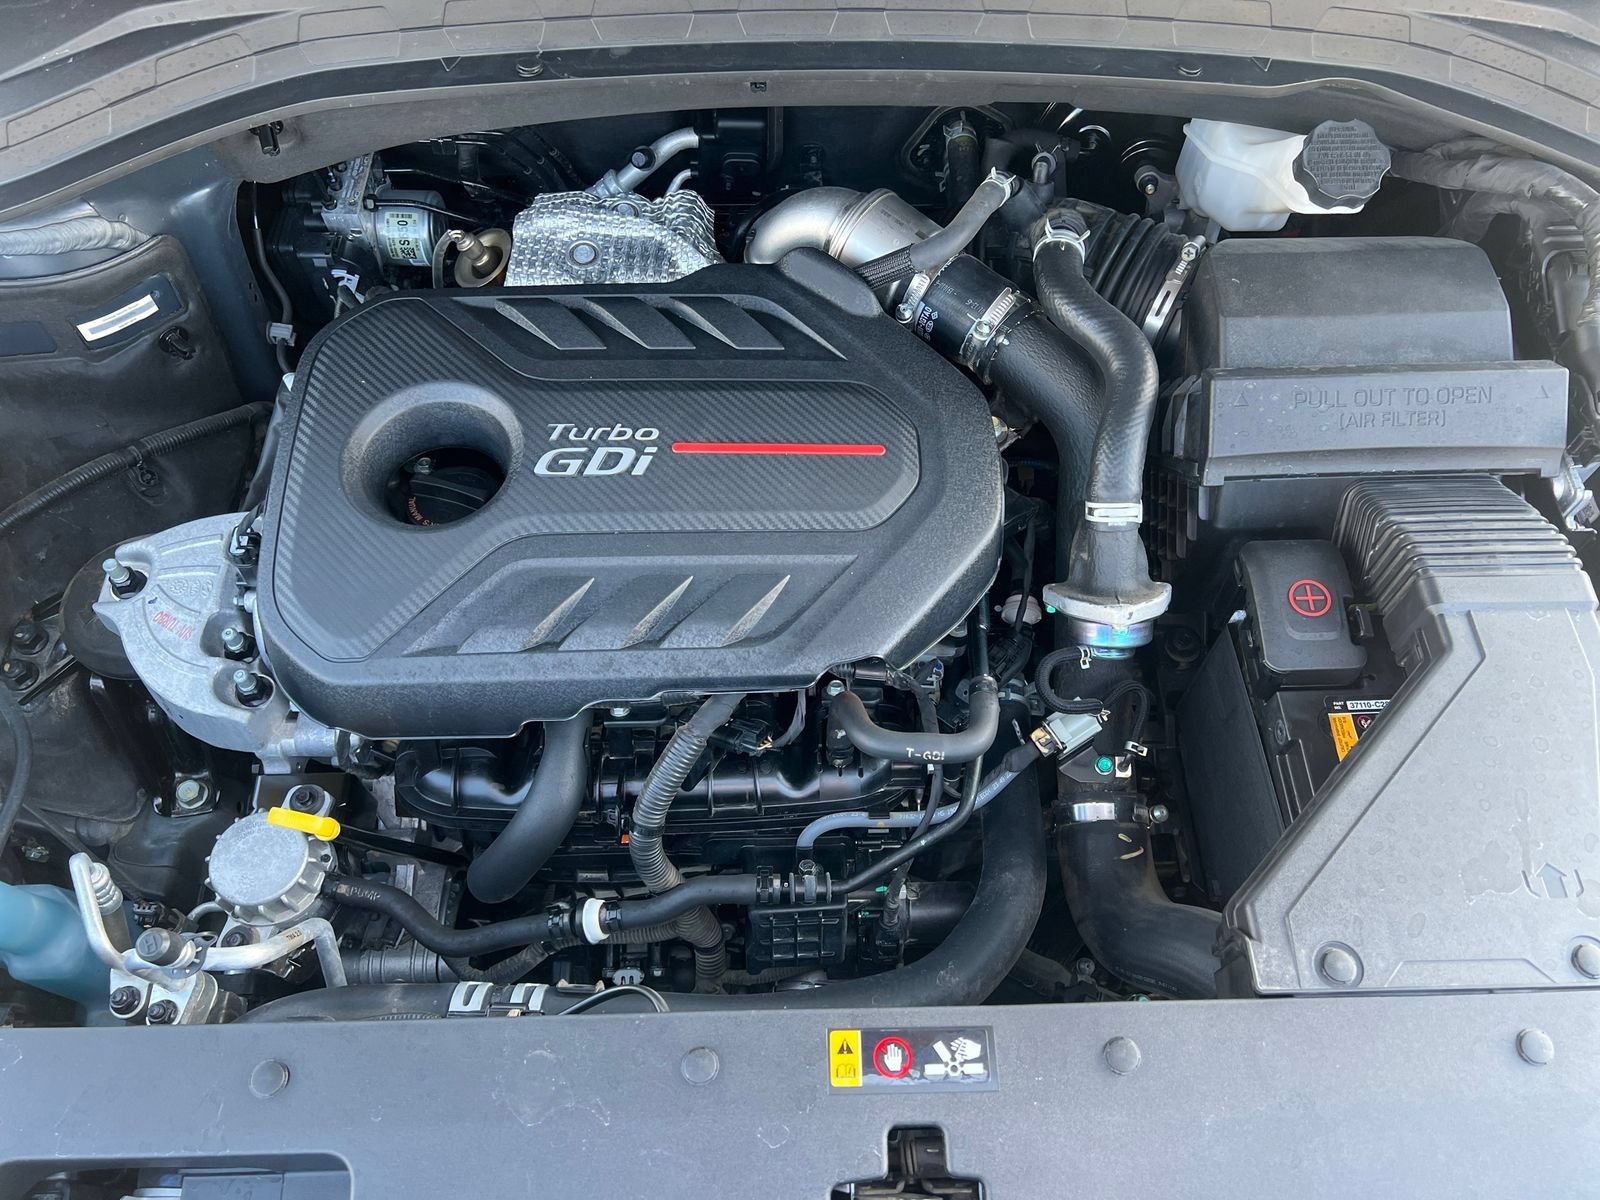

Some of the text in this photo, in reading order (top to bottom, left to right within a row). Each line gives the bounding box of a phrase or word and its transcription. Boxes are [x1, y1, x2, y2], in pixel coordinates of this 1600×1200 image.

[1293, 386, 1493, 408] PULL OUT TO OPEN
[547, 423, 660, 441] Turbo
[533, 446, 658, 477] GDi
